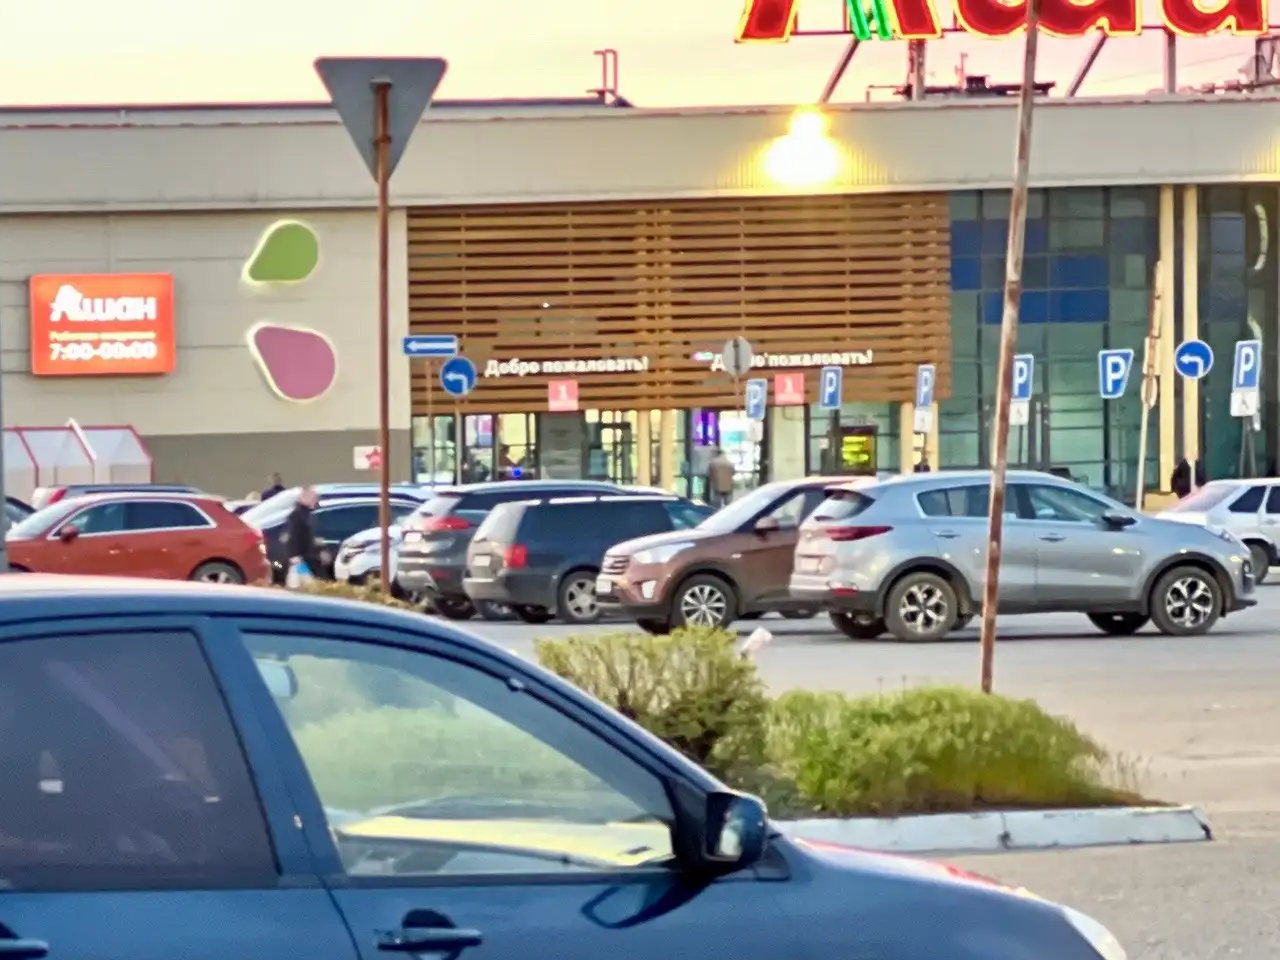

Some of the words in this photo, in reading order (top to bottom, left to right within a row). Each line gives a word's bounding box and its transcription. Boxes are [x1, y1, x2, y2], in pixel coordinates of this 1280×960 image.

[50, 284, 157, 322] Ашан
[484, 358, 540, 378] Добро
[543, 356, 649, 373] пожаловать!
[768, 349, 874, 367] пожаловать!
[1106, 356, 1126, 392] P
[1239, 347, 1254, 384] P
[824, 372, 837, 403] P
[1014, 361, 1028, 396] P
